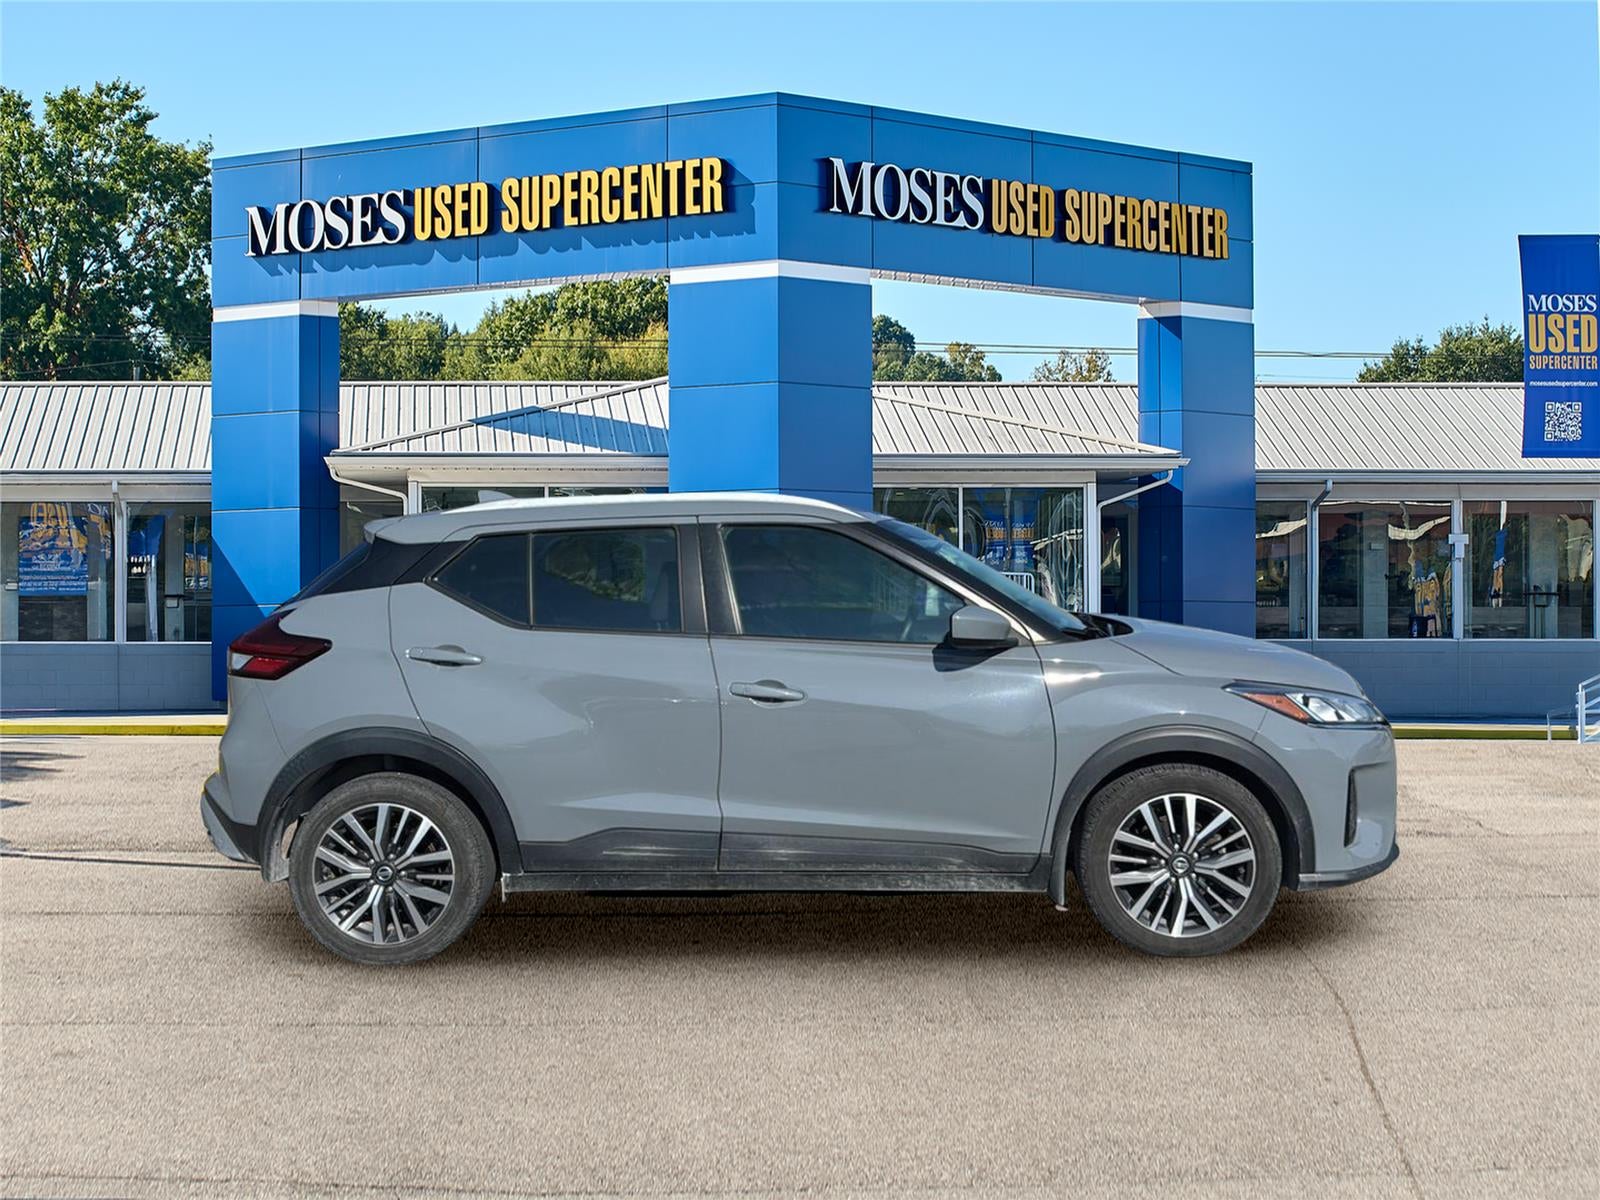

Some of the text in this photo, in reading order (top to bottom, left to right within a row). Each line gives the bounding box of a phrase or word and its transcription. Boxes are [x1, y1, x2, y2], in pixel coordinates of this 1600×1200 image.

[243, 157, 724, 257] MOSES USED SUPERCENTER
[829, 157, 1230, 260] MOSES USED SUPERCENTER
[1528, 294, 1597, 312] MOSES
[1529, 314, 1598, 353] USED
[1529, 354, 1598, 370] SUPERCENTER
